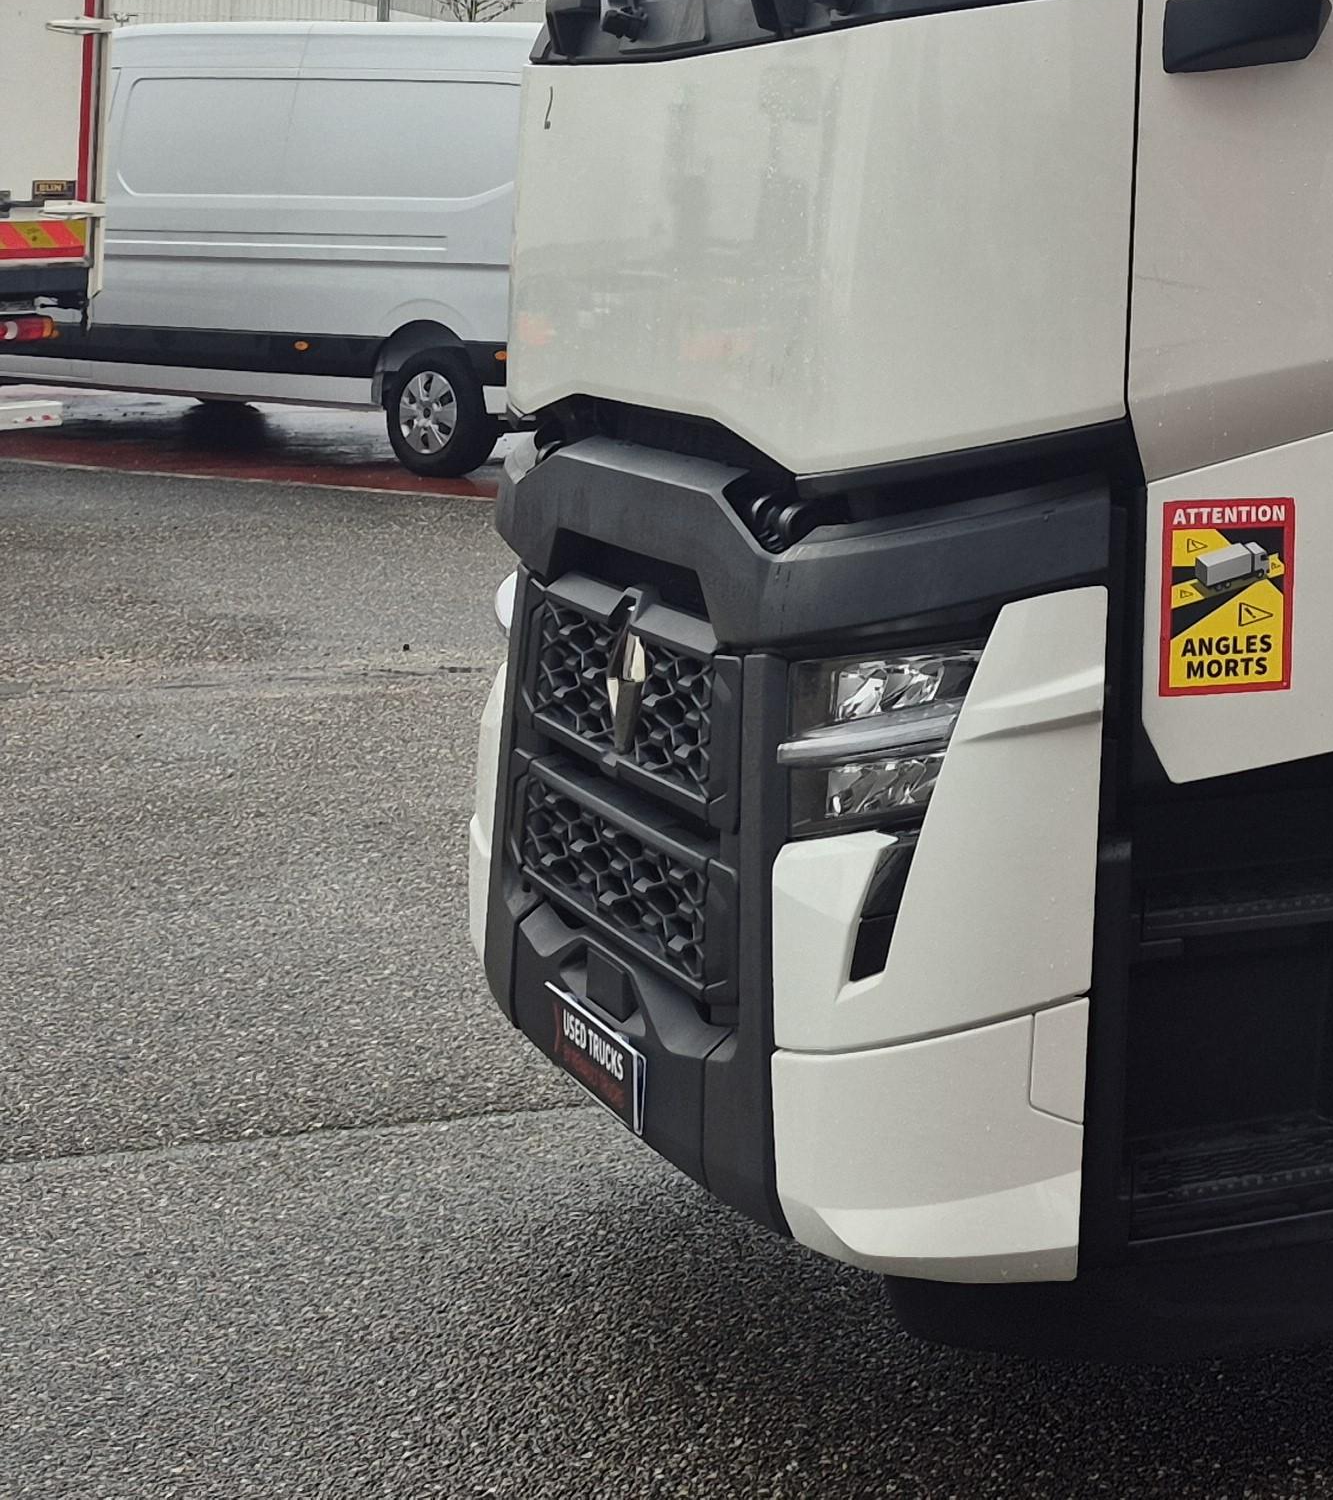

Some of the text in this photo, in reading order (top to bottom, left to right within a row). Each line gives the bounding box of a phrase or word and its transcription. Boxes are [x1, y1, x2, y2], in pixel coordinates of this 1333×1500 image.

[1172, 504, 1286, 525] ATTENTION
[1181, 634, 1272, 657] ANGLES
[1186, 657, 1268, 679] MORTS
[562, 1008, 587, 1050] USED
[588, 1028, 624, 1081] TRUCKS
